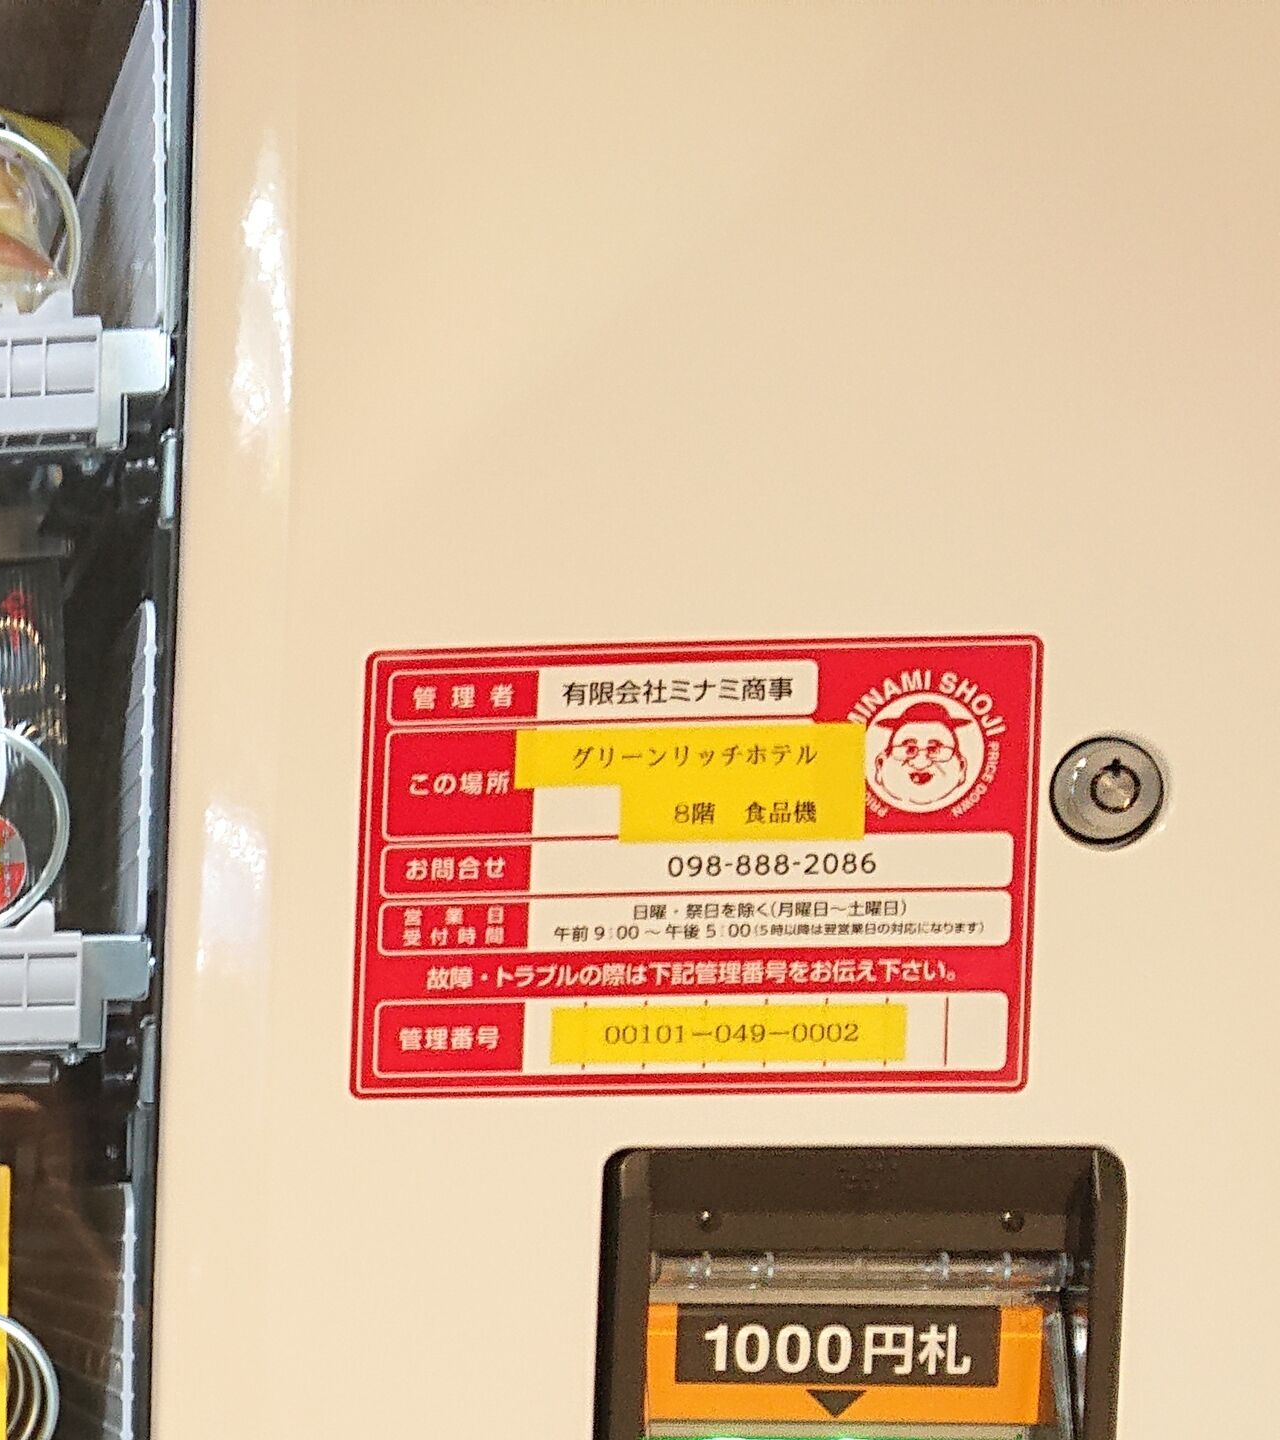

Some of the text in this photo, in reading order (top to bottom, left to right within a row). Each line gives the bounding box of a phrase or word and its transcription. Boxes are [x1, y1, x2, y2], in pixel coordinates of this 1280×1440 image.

[562, 676, 794, 708] 有限会社ミナミ商事
[939, 670, 1007, 737] SHOJI
[572, 744, 818, 770] グリーンリッチホテル
[408, 771, 511, 797] この場所
[744, 800, 818, 825] 食品機
[405, 857, 506, 881] お問合せ
[668, 851, 877, 877] 098-888-2086
[402, 926, 505, 947] 受付時間
[398, 1025, 500, 1051] 管理番号
[704, 1323, 971, 1376] 1000円札
